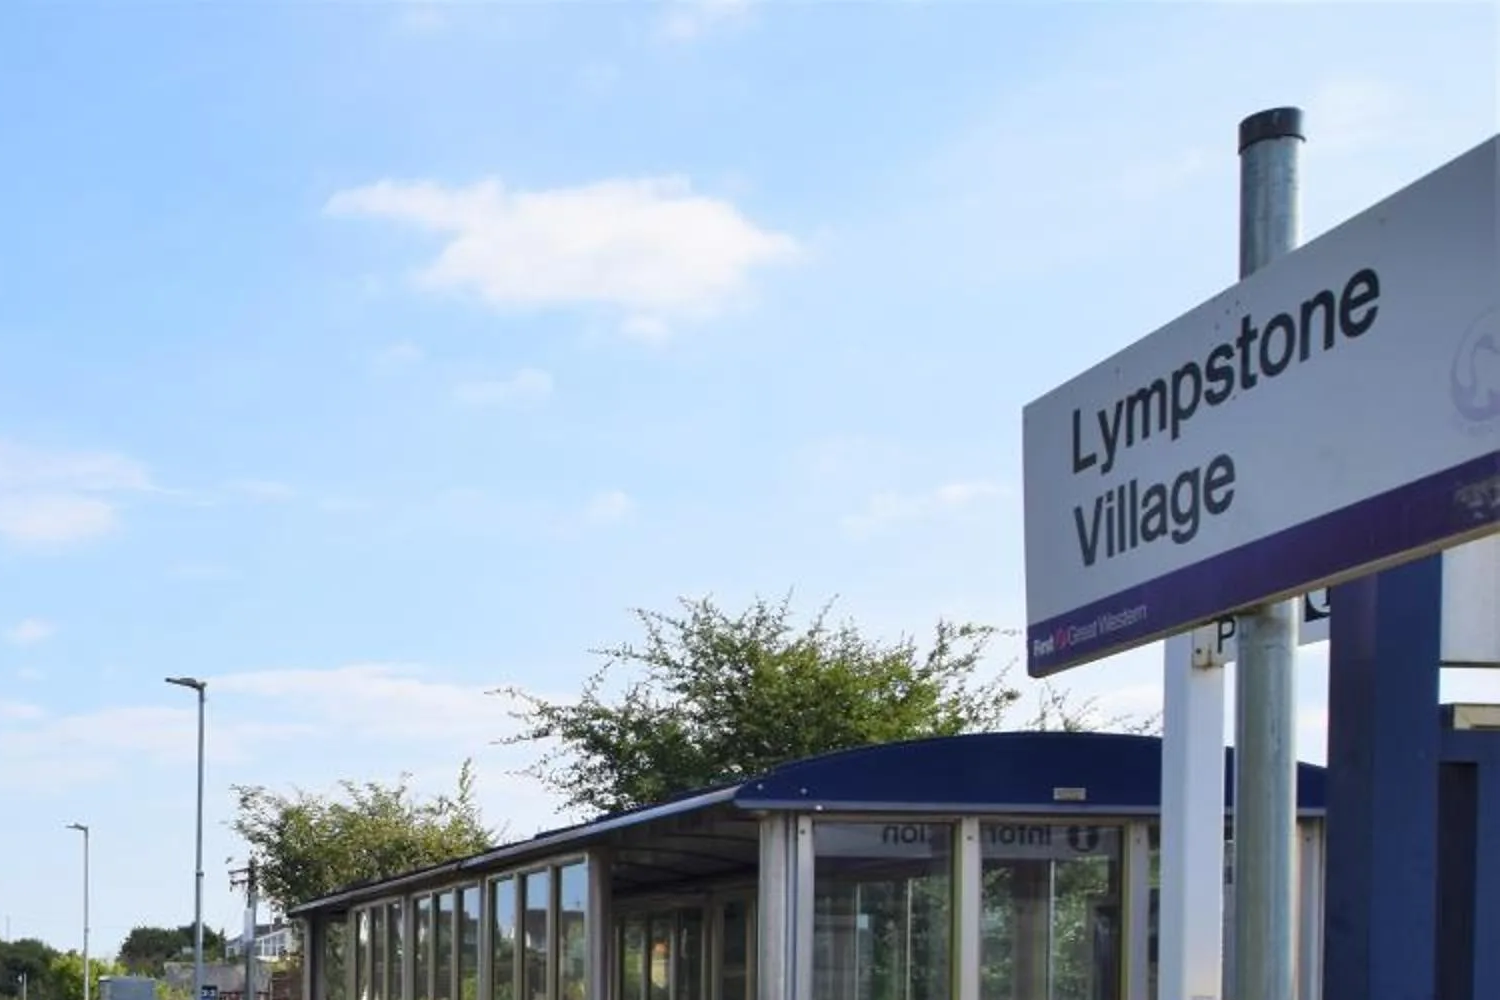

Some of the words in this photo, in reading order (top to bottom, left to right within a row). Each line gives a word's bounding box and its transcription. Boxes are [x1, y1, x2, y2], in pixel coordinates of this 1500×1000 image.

[1073, 268, 1380, 475] Lympstone
[1074, 453, 1236, 567] Village
[1068, 619, 1097, 646] Great
[1097, 604, 1147, 635] Western
